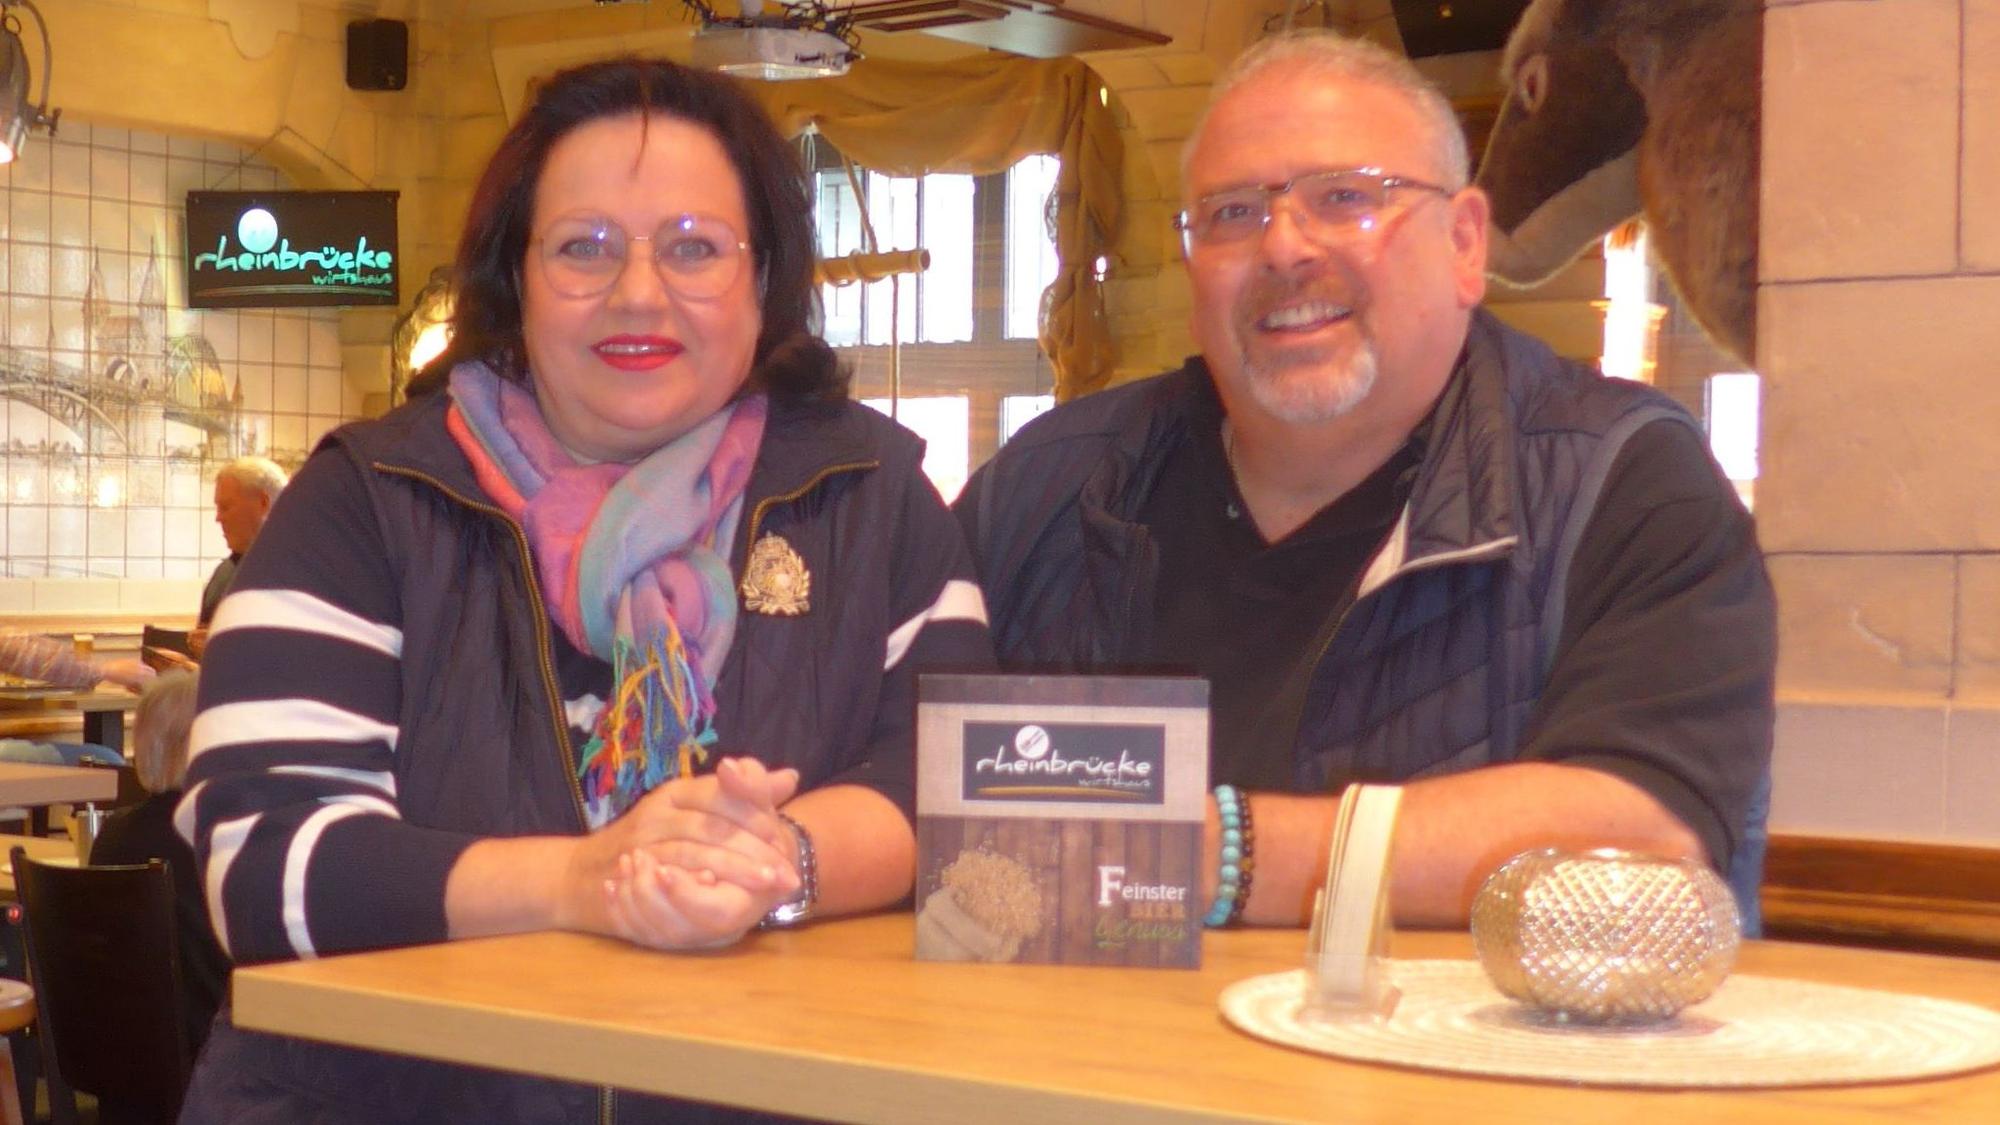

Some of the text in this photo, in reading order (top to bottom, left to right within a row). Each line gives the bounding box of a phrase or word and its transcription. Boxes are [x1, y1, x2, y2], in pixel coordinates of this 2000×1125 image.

[195, 236, 393, 271] rheinbrücke
[312, 271, 393, 285] wirtshaus
[975, 745, 1151, 774] rheinbrücke
[1078, 775, 1151, 788] wirtshaus
[1098, 865, 1186, 907] Feinster
